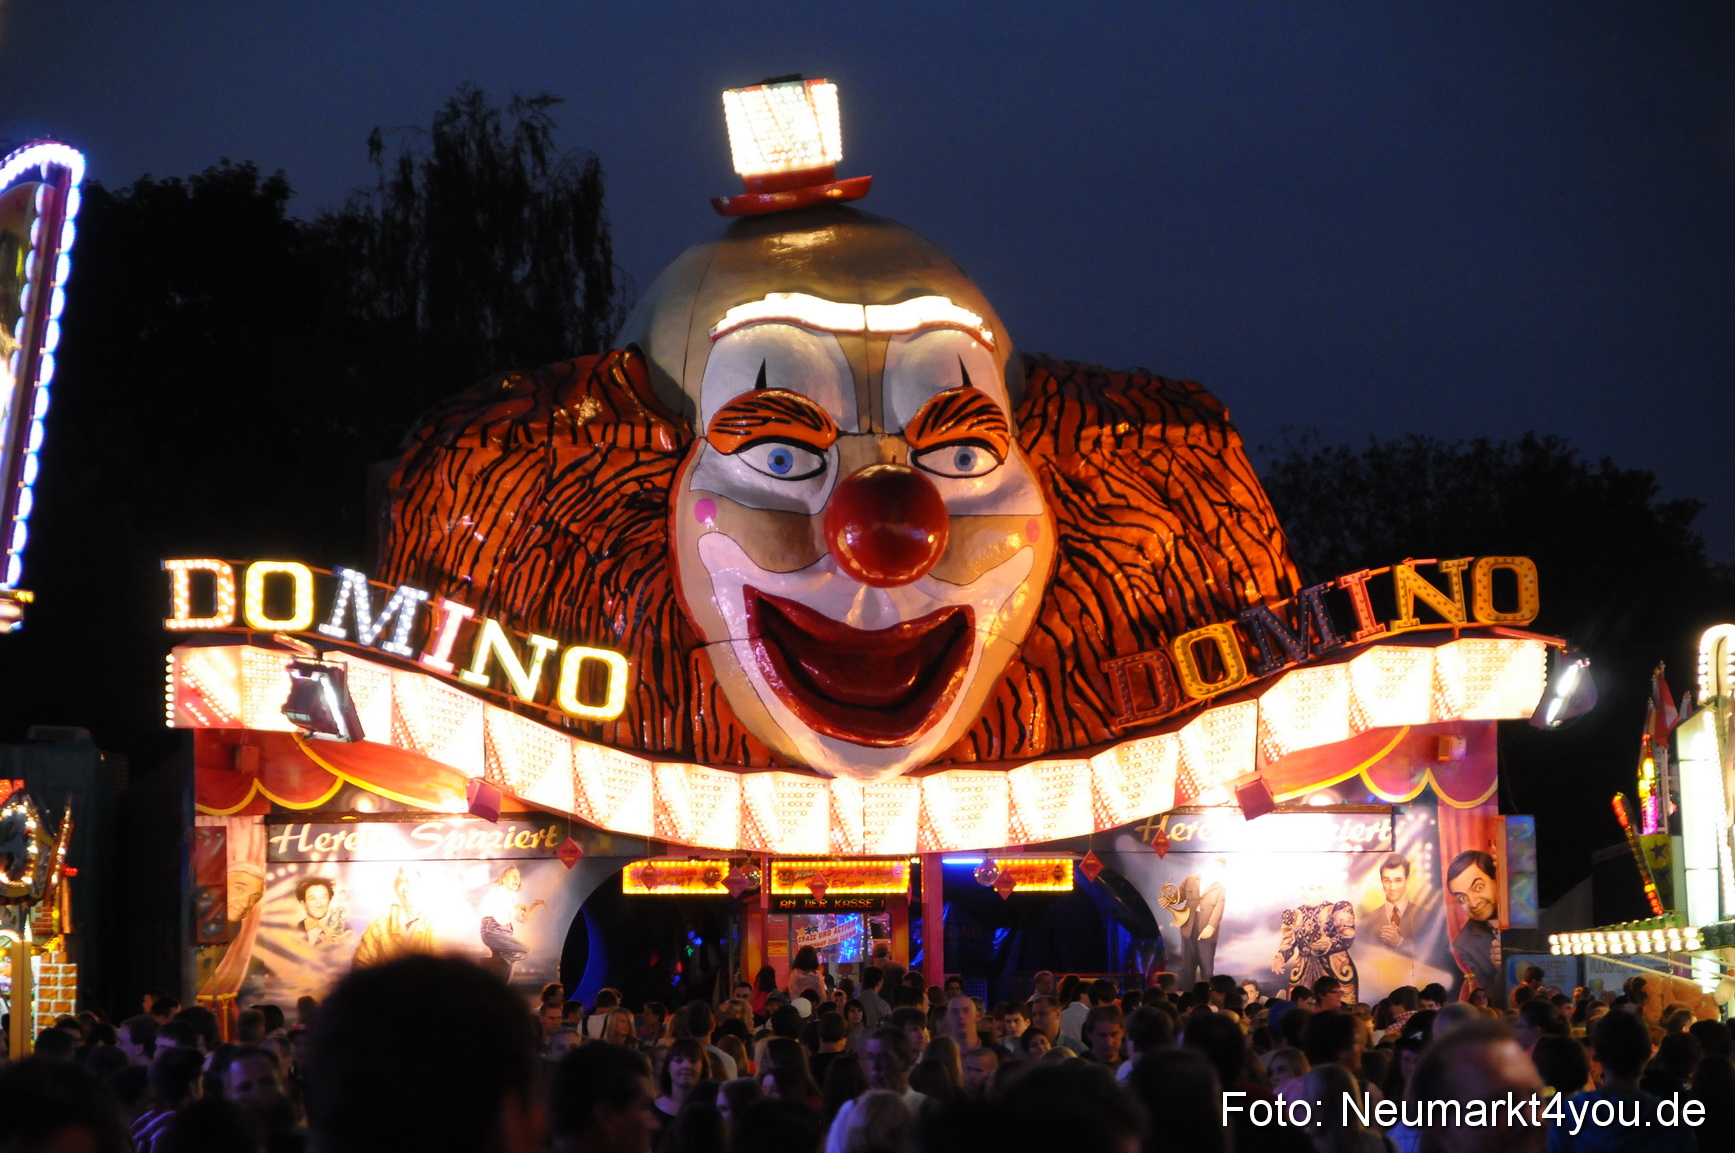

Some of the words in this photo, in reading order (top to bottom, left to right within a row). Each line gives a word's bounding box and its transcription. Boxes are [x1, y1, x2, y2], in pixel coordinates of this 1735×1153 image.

[160, 558, 628, 721] DOMINO
[1103, 556, 1540, 726] DOMINO
[269, 822, 380, 854] Here
[410, 822, 560, 854] Spaziert
[1133, 813, 1216, 843] Here
[779, 898, 797, 909] AN
[803, 898, 828, 909] DER
[834, 898, 874, 909] KASSE
[797, 933, 817, 943] SPASS
[818, 929, 832, 939] UND
[834, 918, 857, 934] ACTION
